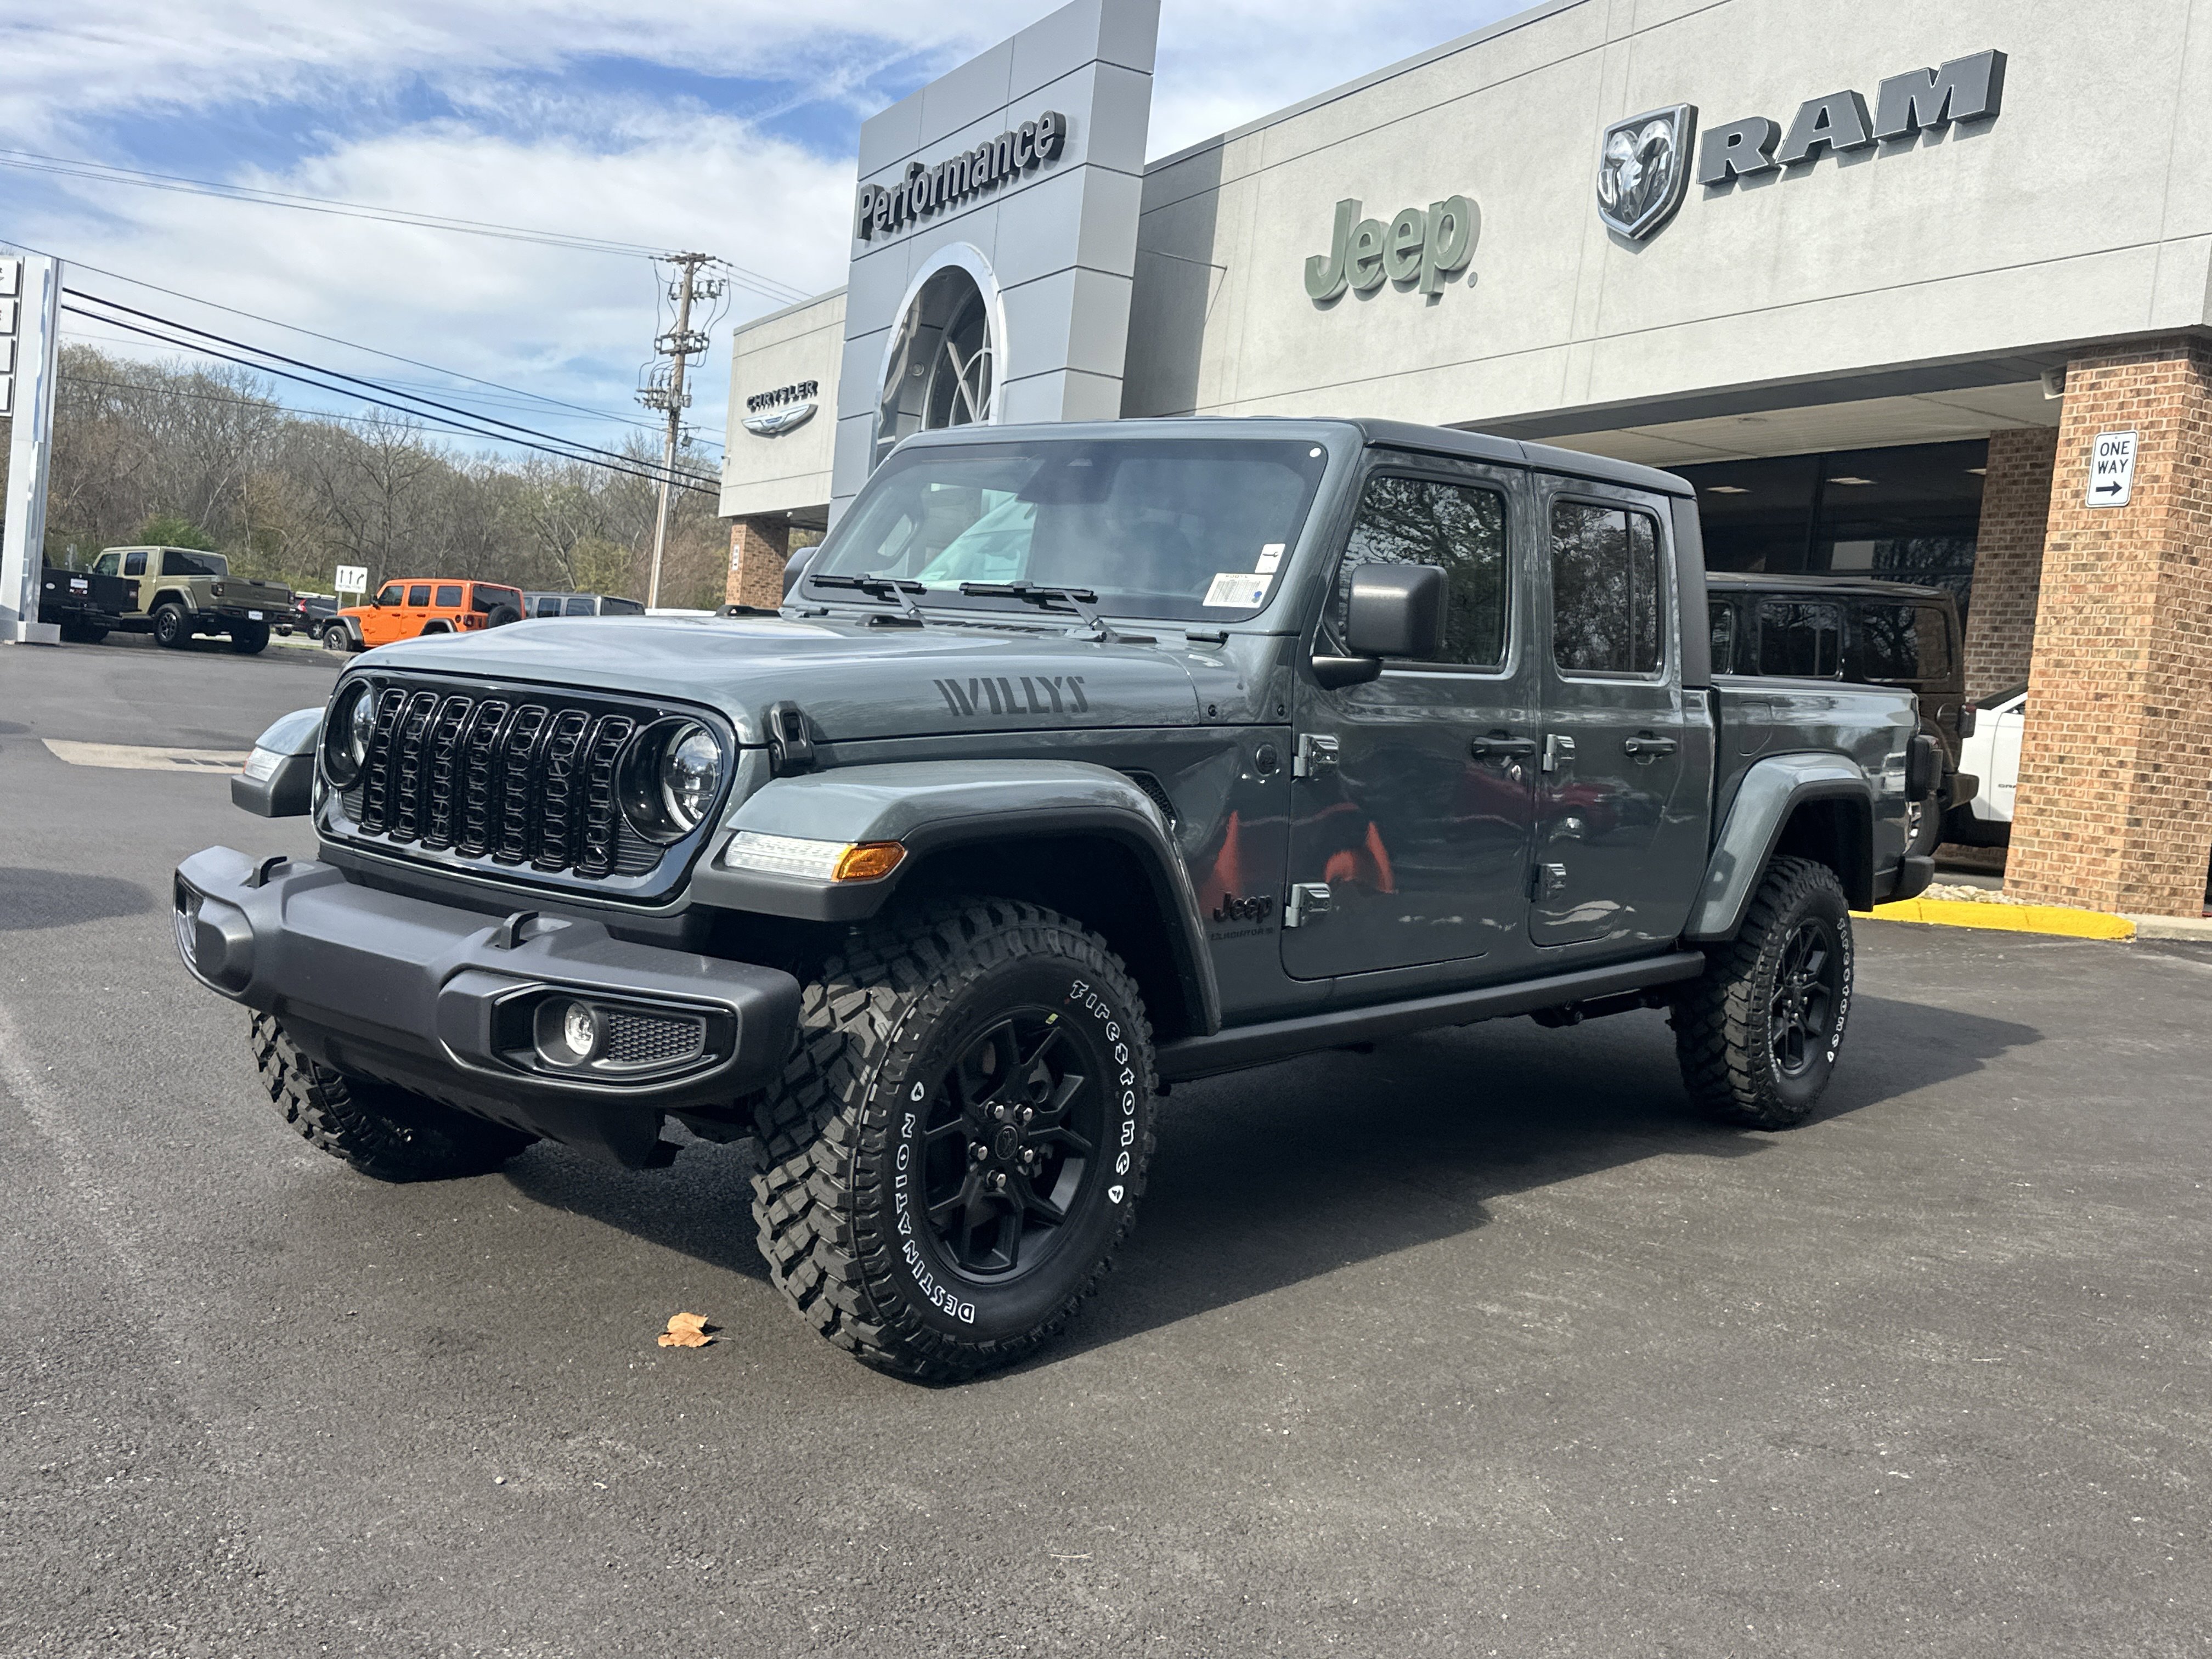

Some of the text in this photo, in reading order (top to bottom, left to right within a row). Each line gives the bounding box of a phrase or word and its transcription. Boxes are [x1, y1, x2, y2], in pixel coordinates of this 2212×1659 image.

[1696, 49, 2008, 186] RAM
[857, 110, 1066, 240] Performance
[1304, 195, 1481, 295] Jeep
[747, 380, 819, 410] CHRYSLER
[2098, 459, 2129, 475] WAY
[2100, 441, 2130, 456] ONE
[933, 676, 1088, 716] WILLYS
[1213, 891, 1272, 923] Jeep
[895, 1113, 975, 1324] DESTINATION
